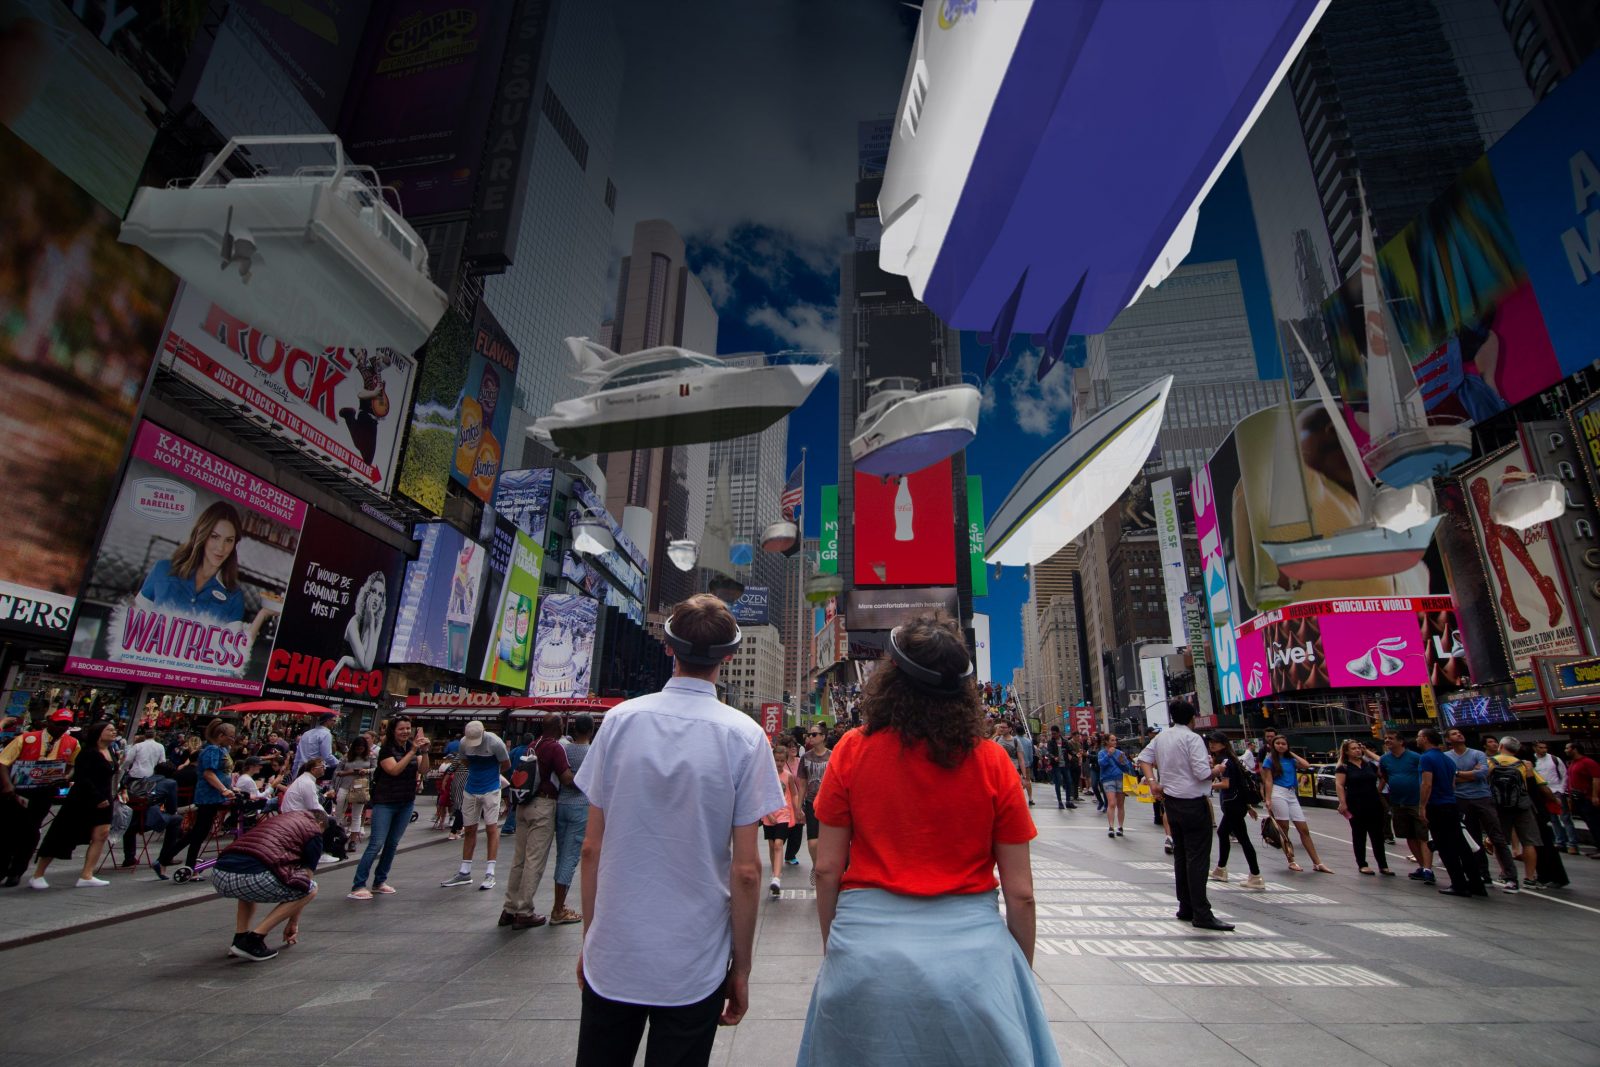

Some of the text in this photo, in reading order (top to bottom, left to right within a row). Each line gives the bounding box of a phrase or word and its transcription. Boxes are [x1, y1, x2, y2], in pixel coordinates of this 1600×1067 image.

[387, 9, 474, 53] CHARLIE
[481, 54, 530, 209] SQUARE
[474, 328, 515, 374] FLAVOR
[263, 378, 289, 398] MUSICAL
[214, 368, 374, 477] JUST 4 BLOCKS TO THE WINTER GARDEN THEATRE
[156, 432, 297, 512] KATHARINE McPHEE
[152, 448, 295, 522] NOW STARRING ON BROADWAY
[152, 490, 176, 502] SARA
[140, 497, 186, 512] BAREILLES
[1161, 490, 1178, 548] 10,000 SF
[493, 537, 511, 555] HARD
[495, 526, 513, 545] WORK
[490, 557, 507, 576] HARD
[492, 547, 510, 565] PLAY
[518, 543, 538, 567] RELAX
[306, 561, 355, 589] IT WOULD BE
[303, 580, 350, 605] CRIMINAL TO
[311, 602, 340, 619] MISS IT
[1289, 598, 1413, 616] HERSHEY'S CHOCOLATE WORLD
[122, 606, 248, 668] WAITRESS
[1187, 609, 1206, 668] EXPERIENCE
[1511, 635, 1535, 650] WINNER!
[1535, 634, 1540, 645] 6
[1540, 630, 1555, 642] TONY
[1514, 645, 1539, 656] INCLUDING
[1539, 641, 1555, 651] BEST
[78, 661, 102, 672] BROOKS
[103, 665, 136, 677] ATKINSON
[136, 669, 162, 680] THEATRE
[136, 655, 158, 664] PLAYING
[176, 661, 194, 669] BROOKS
[267, 648, 384, 697] CHICAGO
[160, 694, 223, 716] GRAND
[419, 688, 501, 706] nuchas
[553, 698, 603, 706] HOTDOGS
[766, 705, 780, 733] tkts
[1076, 709, 1093, 737] tkts
[1122, 962, 1401, 987] NEDERLANDER
